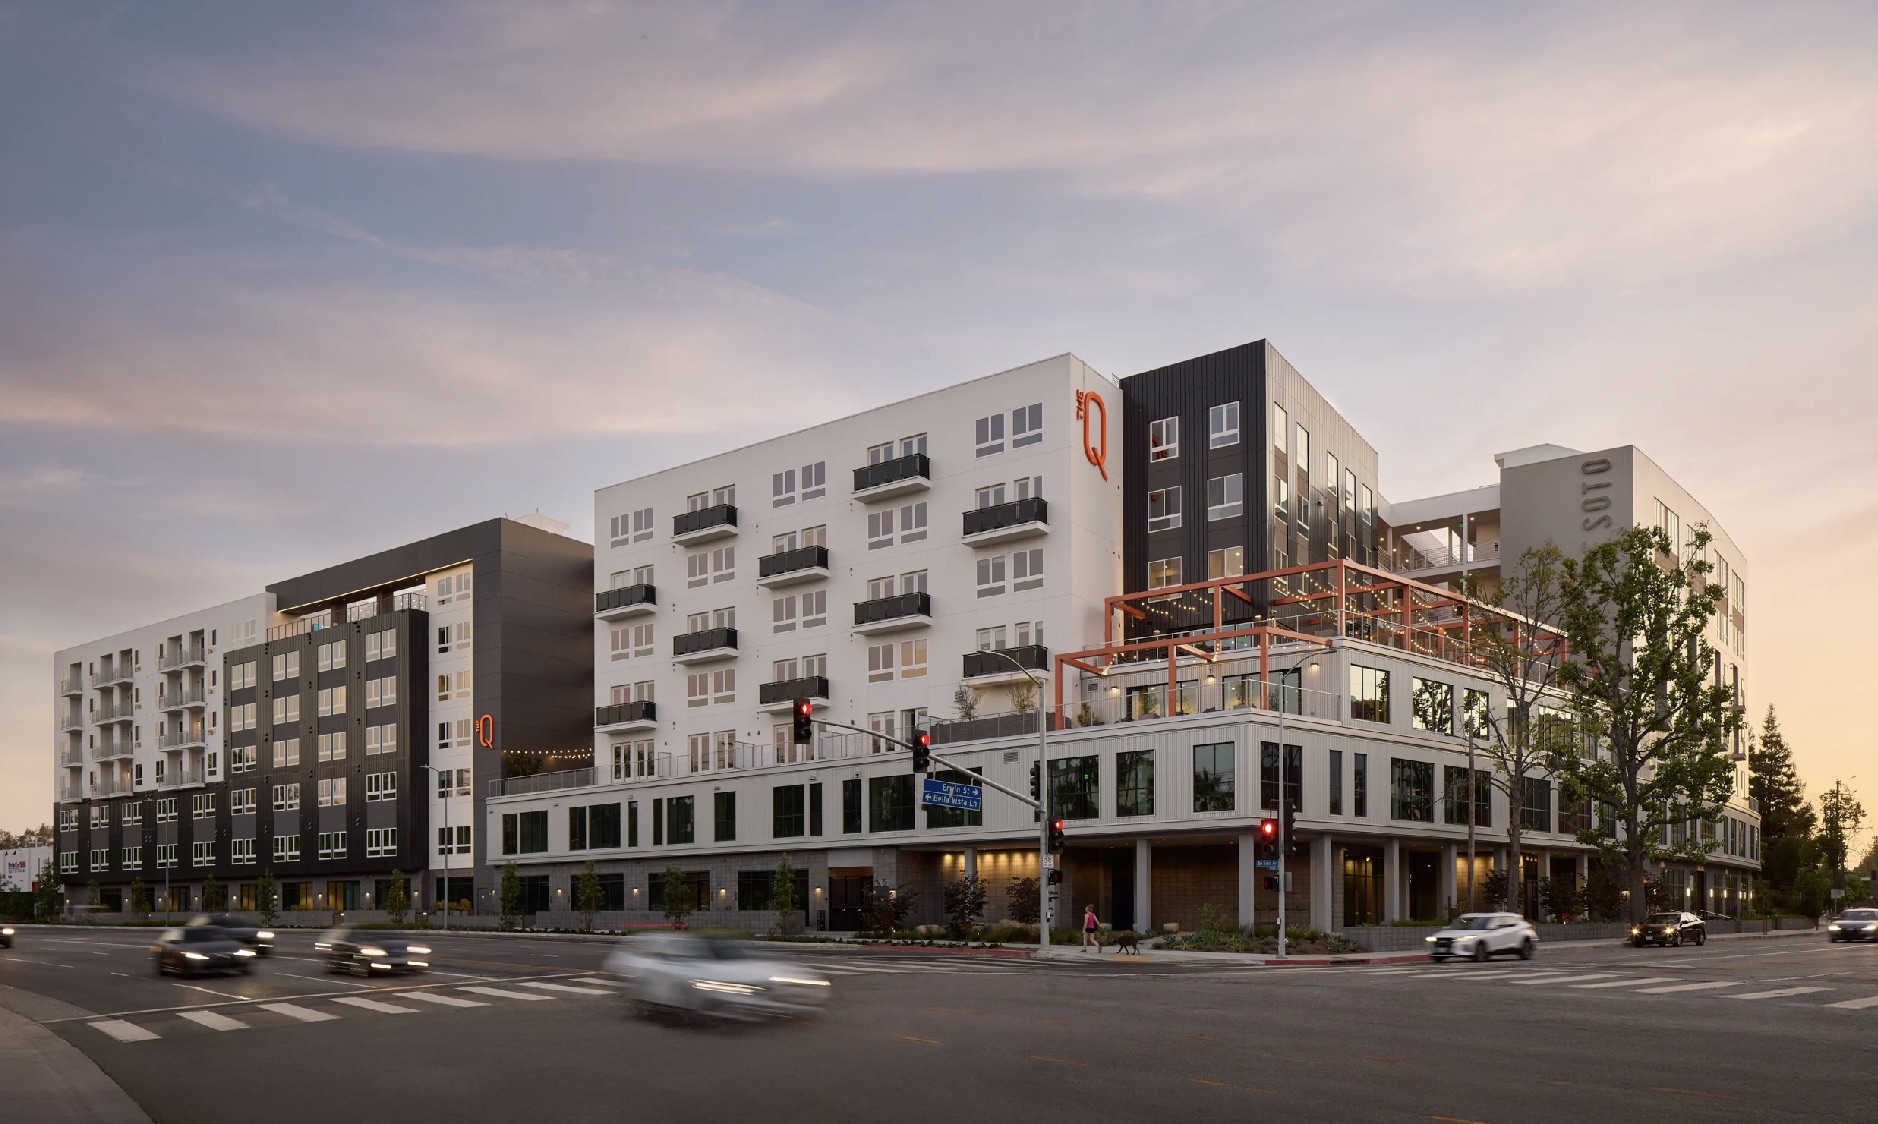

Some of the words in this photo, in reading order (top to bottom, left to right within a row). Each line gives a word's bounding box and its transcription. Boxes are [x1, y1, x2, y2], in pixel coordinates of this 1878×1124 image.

[1076, 388, 1085, 420] THE
[1084, 391, 1108, 482] Q
[1581, 458, 1612, 531] SOTO
[480, 713, 494, 749] Q
[963, 786, 970, 795] St
